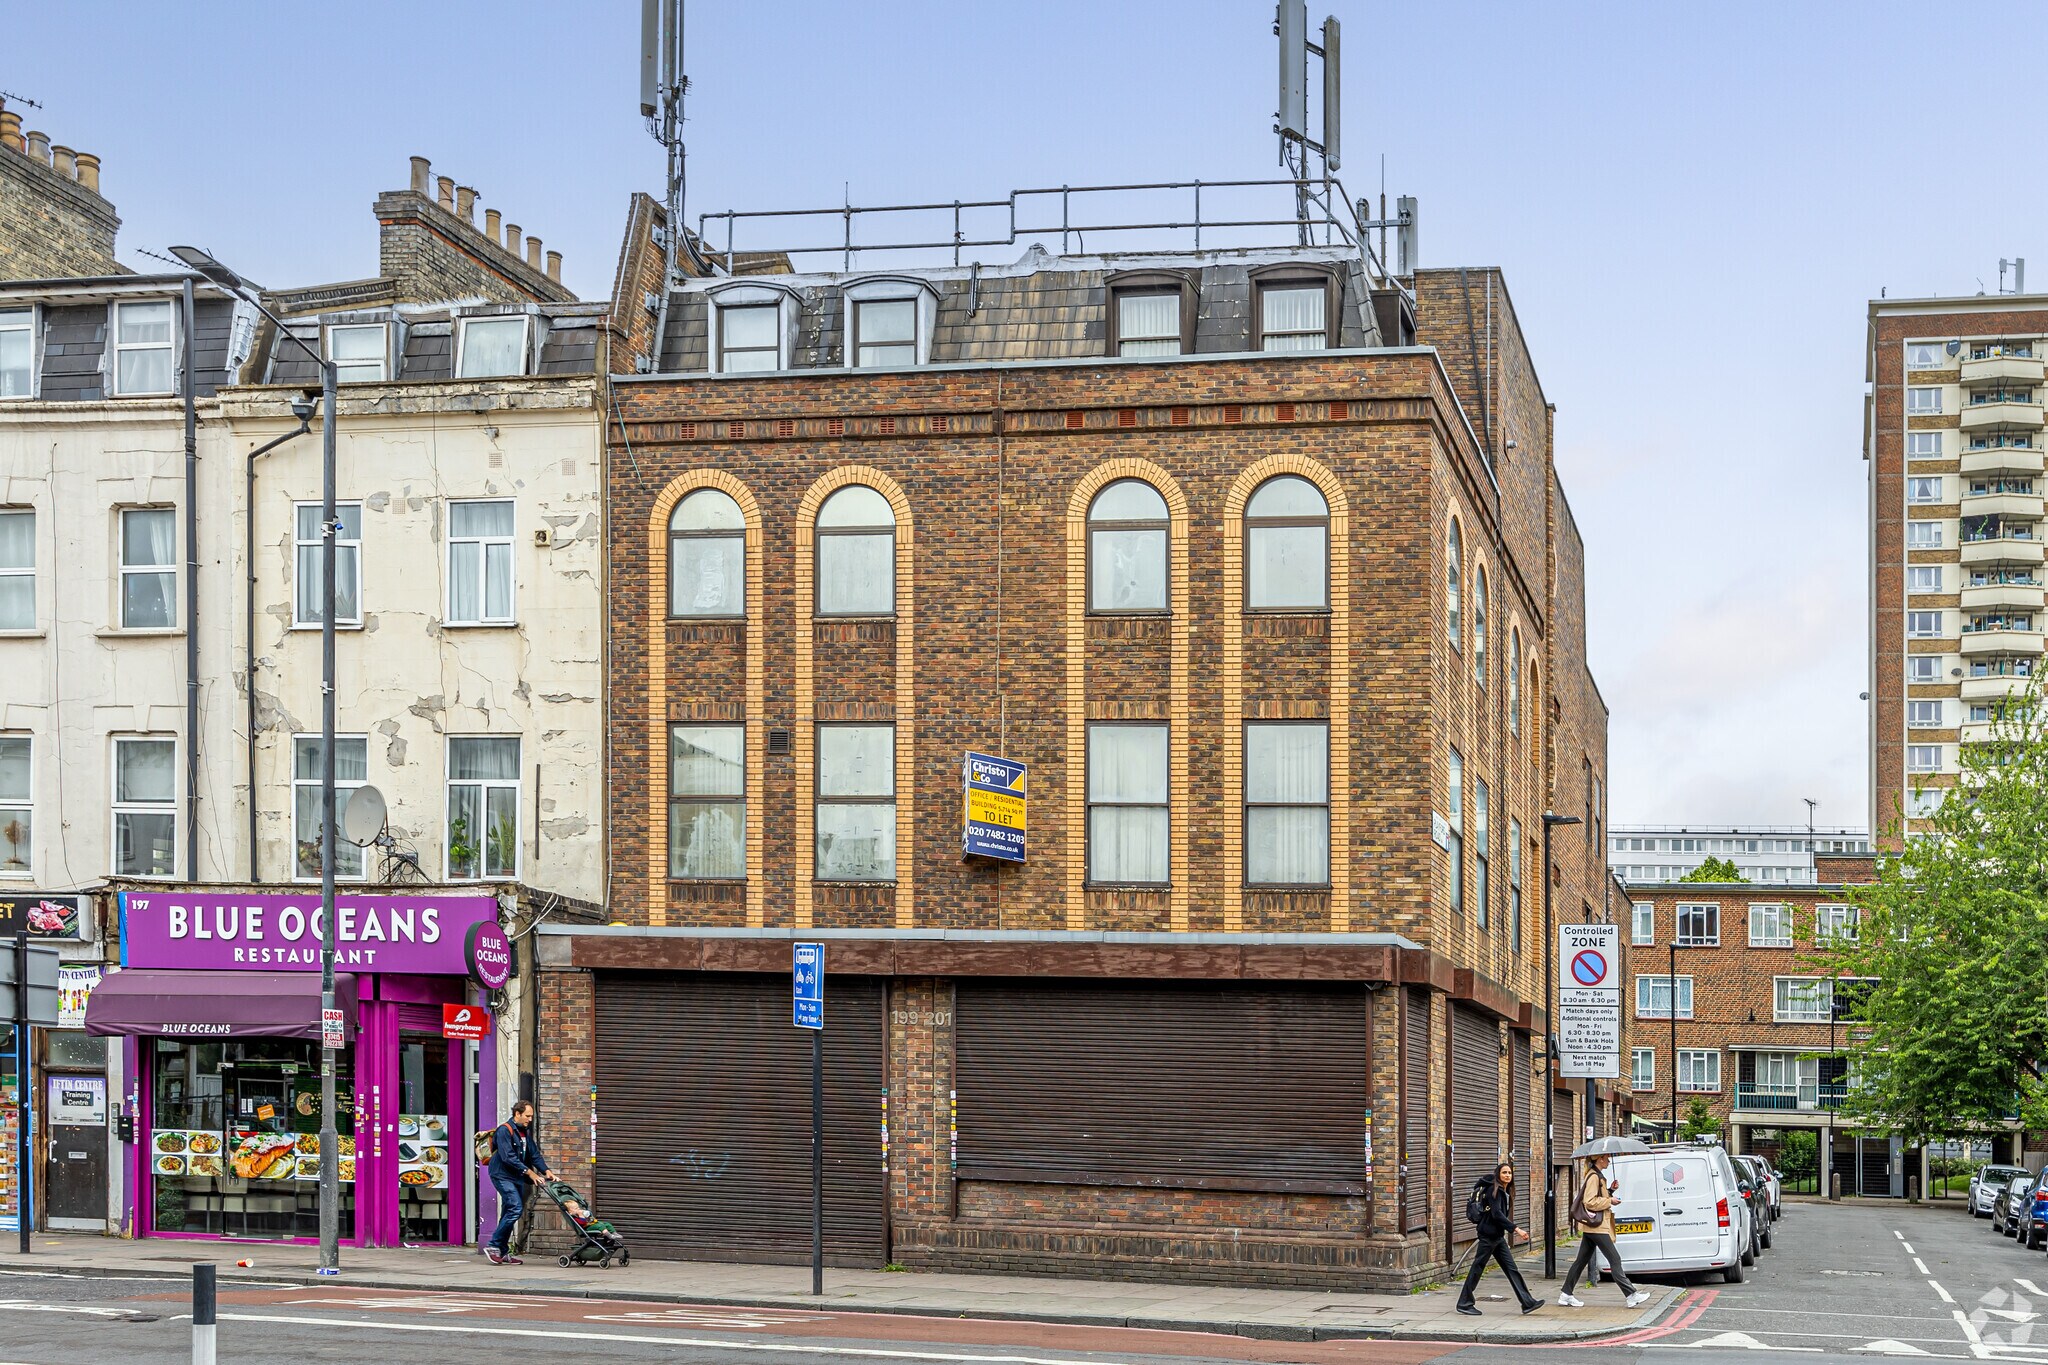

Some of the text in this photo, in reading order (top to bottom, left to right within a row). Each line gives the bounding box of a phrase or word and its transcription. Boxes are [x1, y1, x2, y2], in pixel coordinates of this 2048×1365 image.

[973, 762, 1006, 777] Christo
[973, 772, 990, 783] &Co
[970, 791, 988, 800] OFFICE
[994, 796, 1024, 807] RESIDENTIAL
[971, 800, 997, 809] BUILDING
[984, 811, 1012, 824] TO LET
[969, 826, 1024, 844] 020 7482 1203
[132, 900, 149, 910] 197
[169, 906, 264, 940] BLUE
[1564, 926, 1613, 935] Controlled
[482, 937, 501, 950] BLUE
[1572, 938, 1606, 947] ZONE
[234, 947, 376, 964] RESTAUANT
[477, 949, 508, 964] OCEANS
[72, 969, 97, 979] CENTRE
[478, 963, 508, 983] RESTAURANT
[324, 1011, 342, 1021] CASH
[892, 1010, 951, 1026] 199 201
[161, 1024, 231, 1033] BLUE OCEANS
[444, 1022, 482, 1031] hungryhouse
[53, 1079, 103, 1090] IFTIN CENTRE
